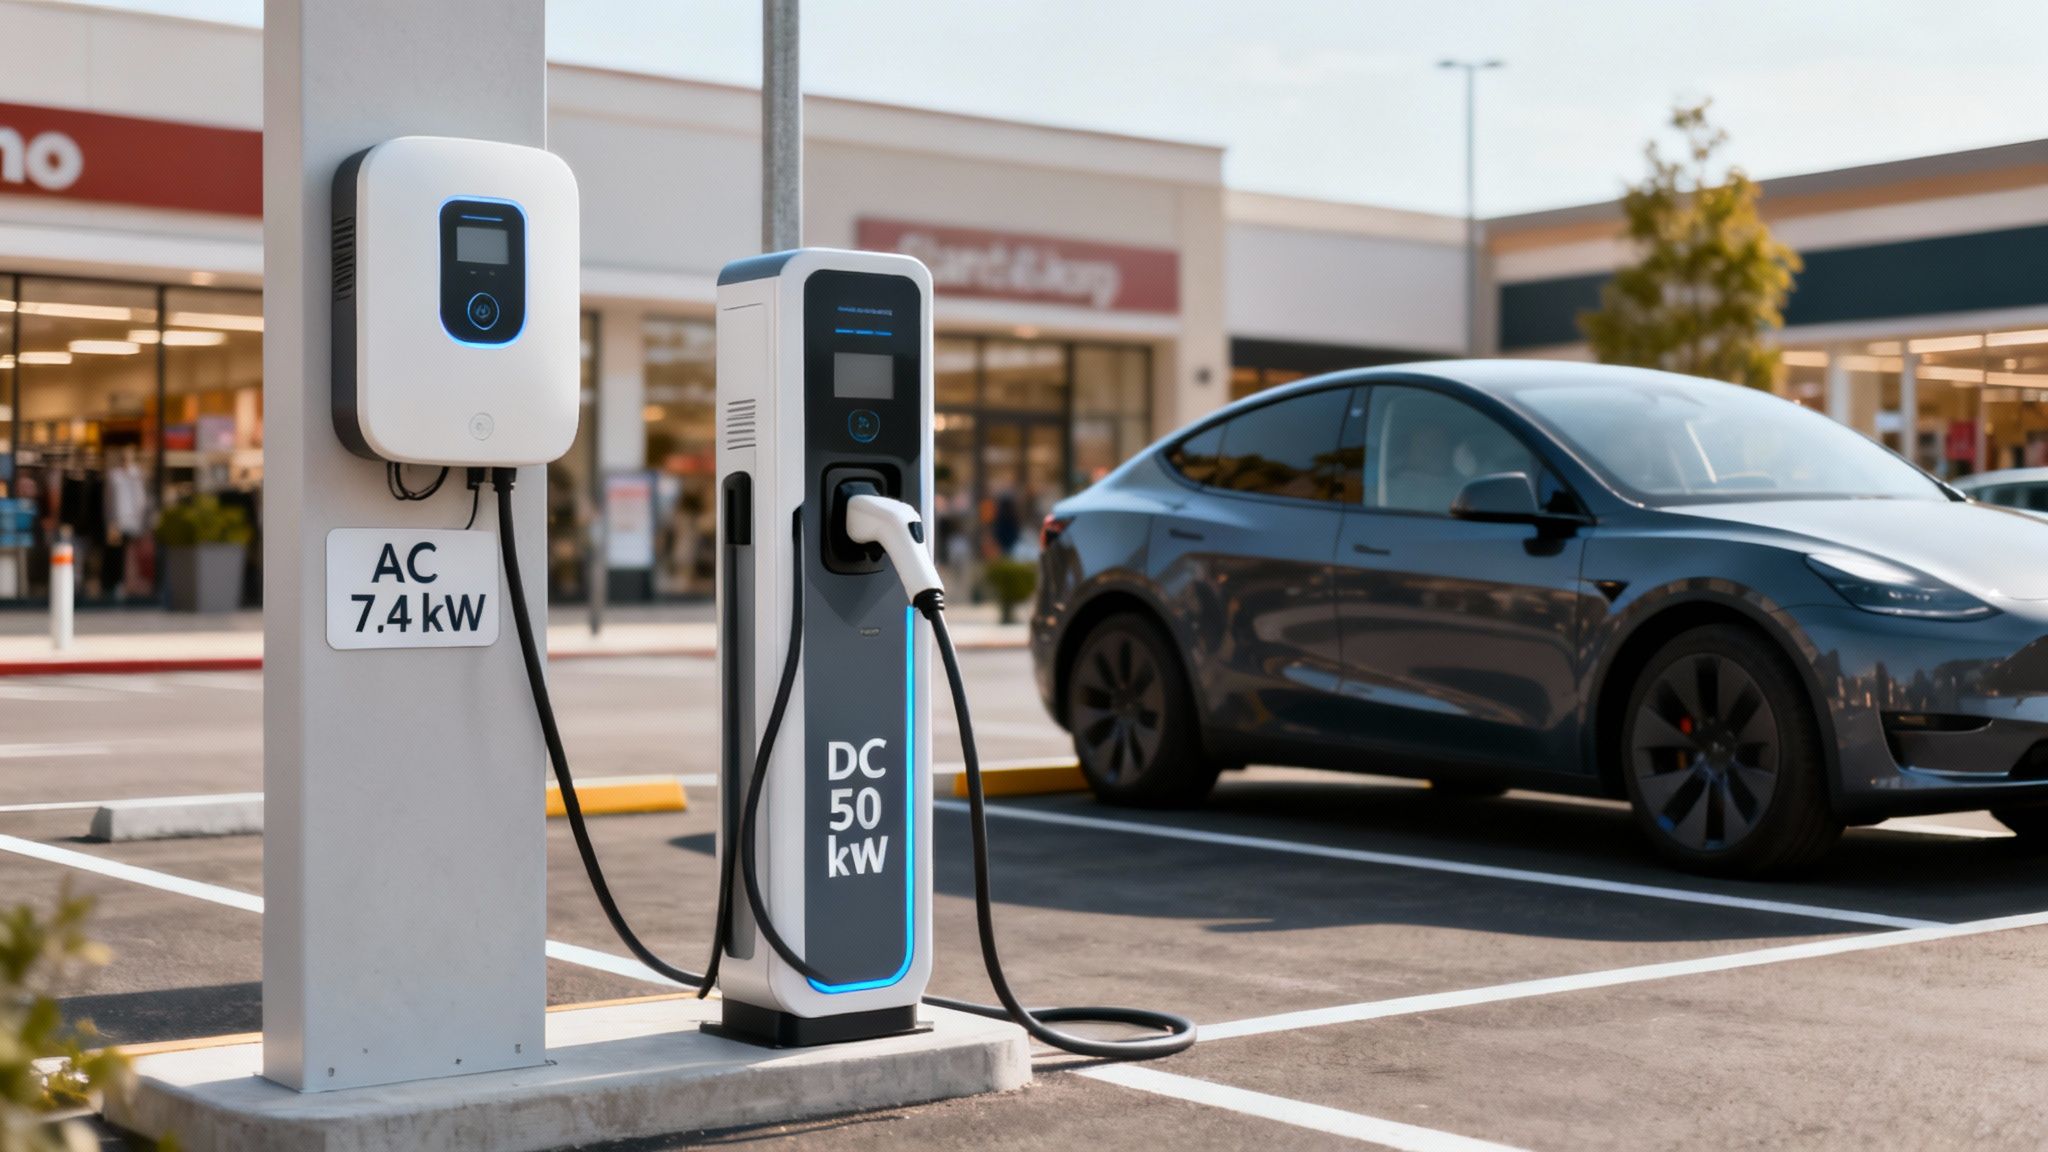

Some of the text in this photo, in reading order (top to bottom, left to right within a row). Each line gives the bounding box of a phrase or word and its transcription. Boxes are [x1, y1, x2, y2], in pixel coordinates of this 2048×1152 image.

[371, 541, 438, 584] AC
[351, 592, 487, 634] 7.4 kW
[828, 737, 887, 781] DC
[829, 786, 882, 832] 50
[828, 834, 889, 878] kW
